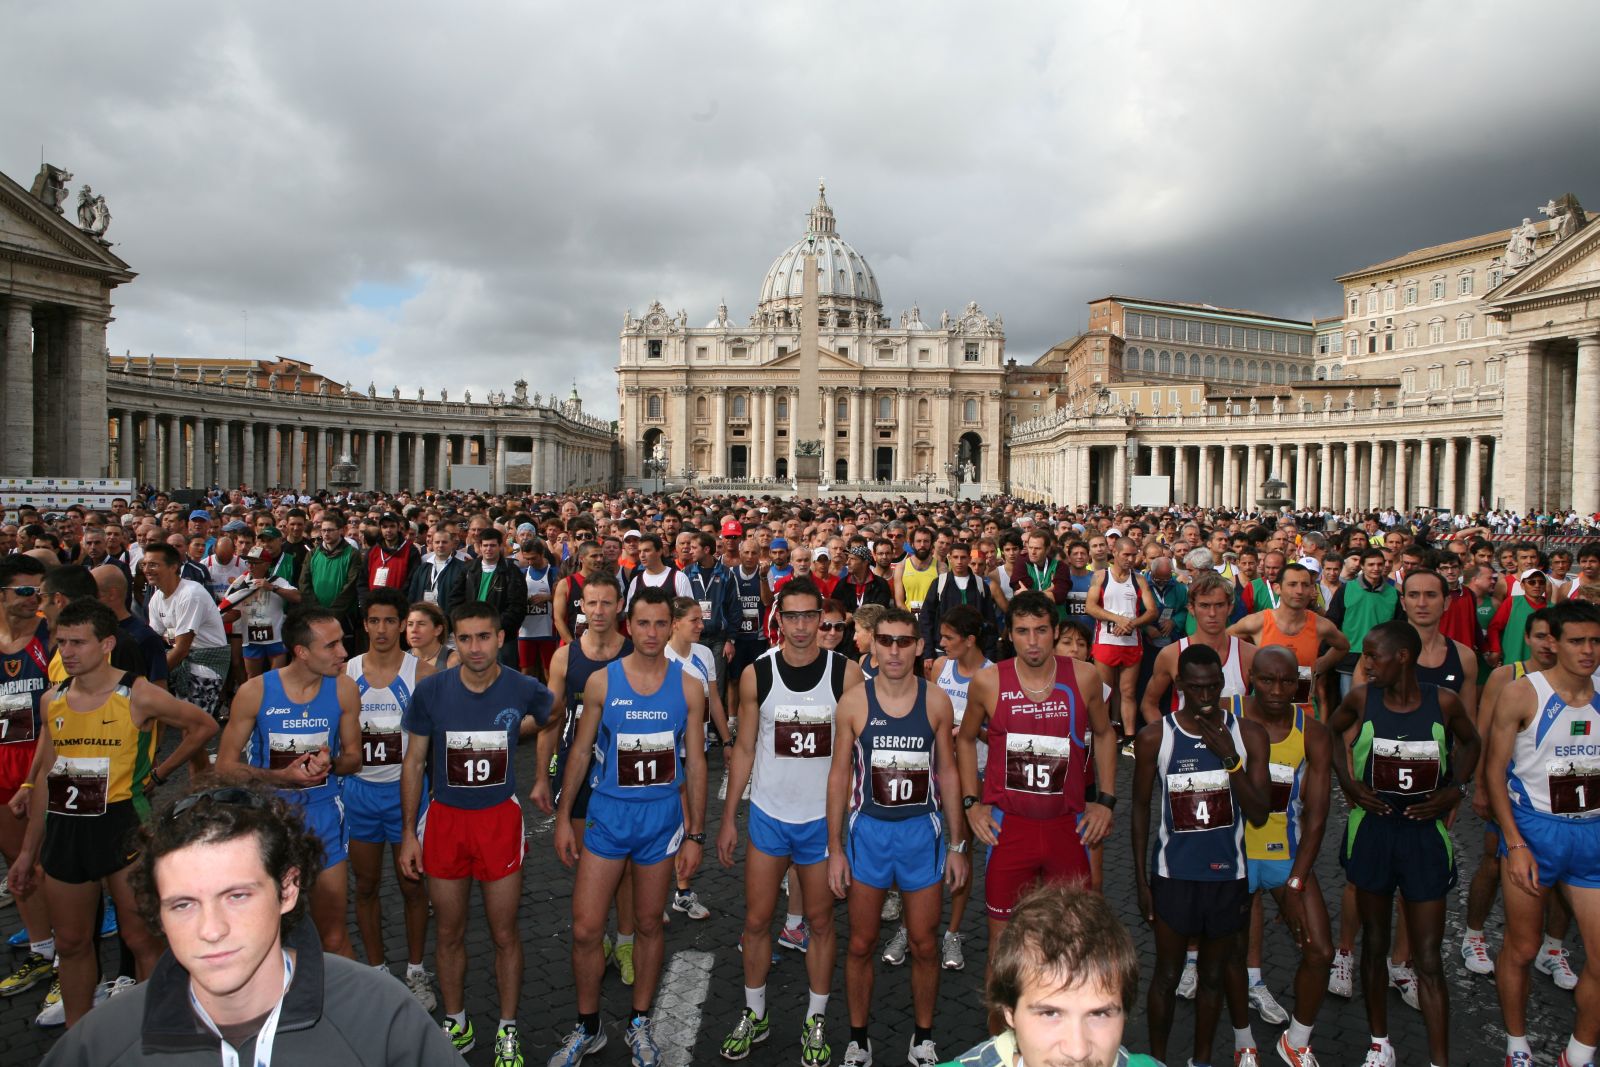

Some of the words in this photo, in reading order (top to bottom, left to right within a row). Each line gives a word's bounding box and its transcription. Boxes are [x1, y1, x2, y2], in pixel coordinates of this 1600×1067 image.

[251, 630, 268, 640] 141
[741, 620, 752, 631] 48
[1001, 691, 1025, 701] FILA
[360, 703, 397, 712] ESERCITO
[625, 710, 668, 720] ESERCITO
[282, 718, 329, 729] ESERCITO
[83, 738, 122, 747] GIALLE
[363, 742, 387, 762] 14
[790, 732, 816, 754] 34
[873, 735, 924, 749] ESERCITO
[464, 759, 490, 782] 19
[634, 760, 657, 781] 11
[1024, 763, 1050, 788] 15
[1398, 768, 1413, 790] 5
[65, 786, 79, 810] 2
[888, 779, 913, 801] 10
[1575, 785, 1586, 807] 1
[1195, 801, 1211, 825] 4
